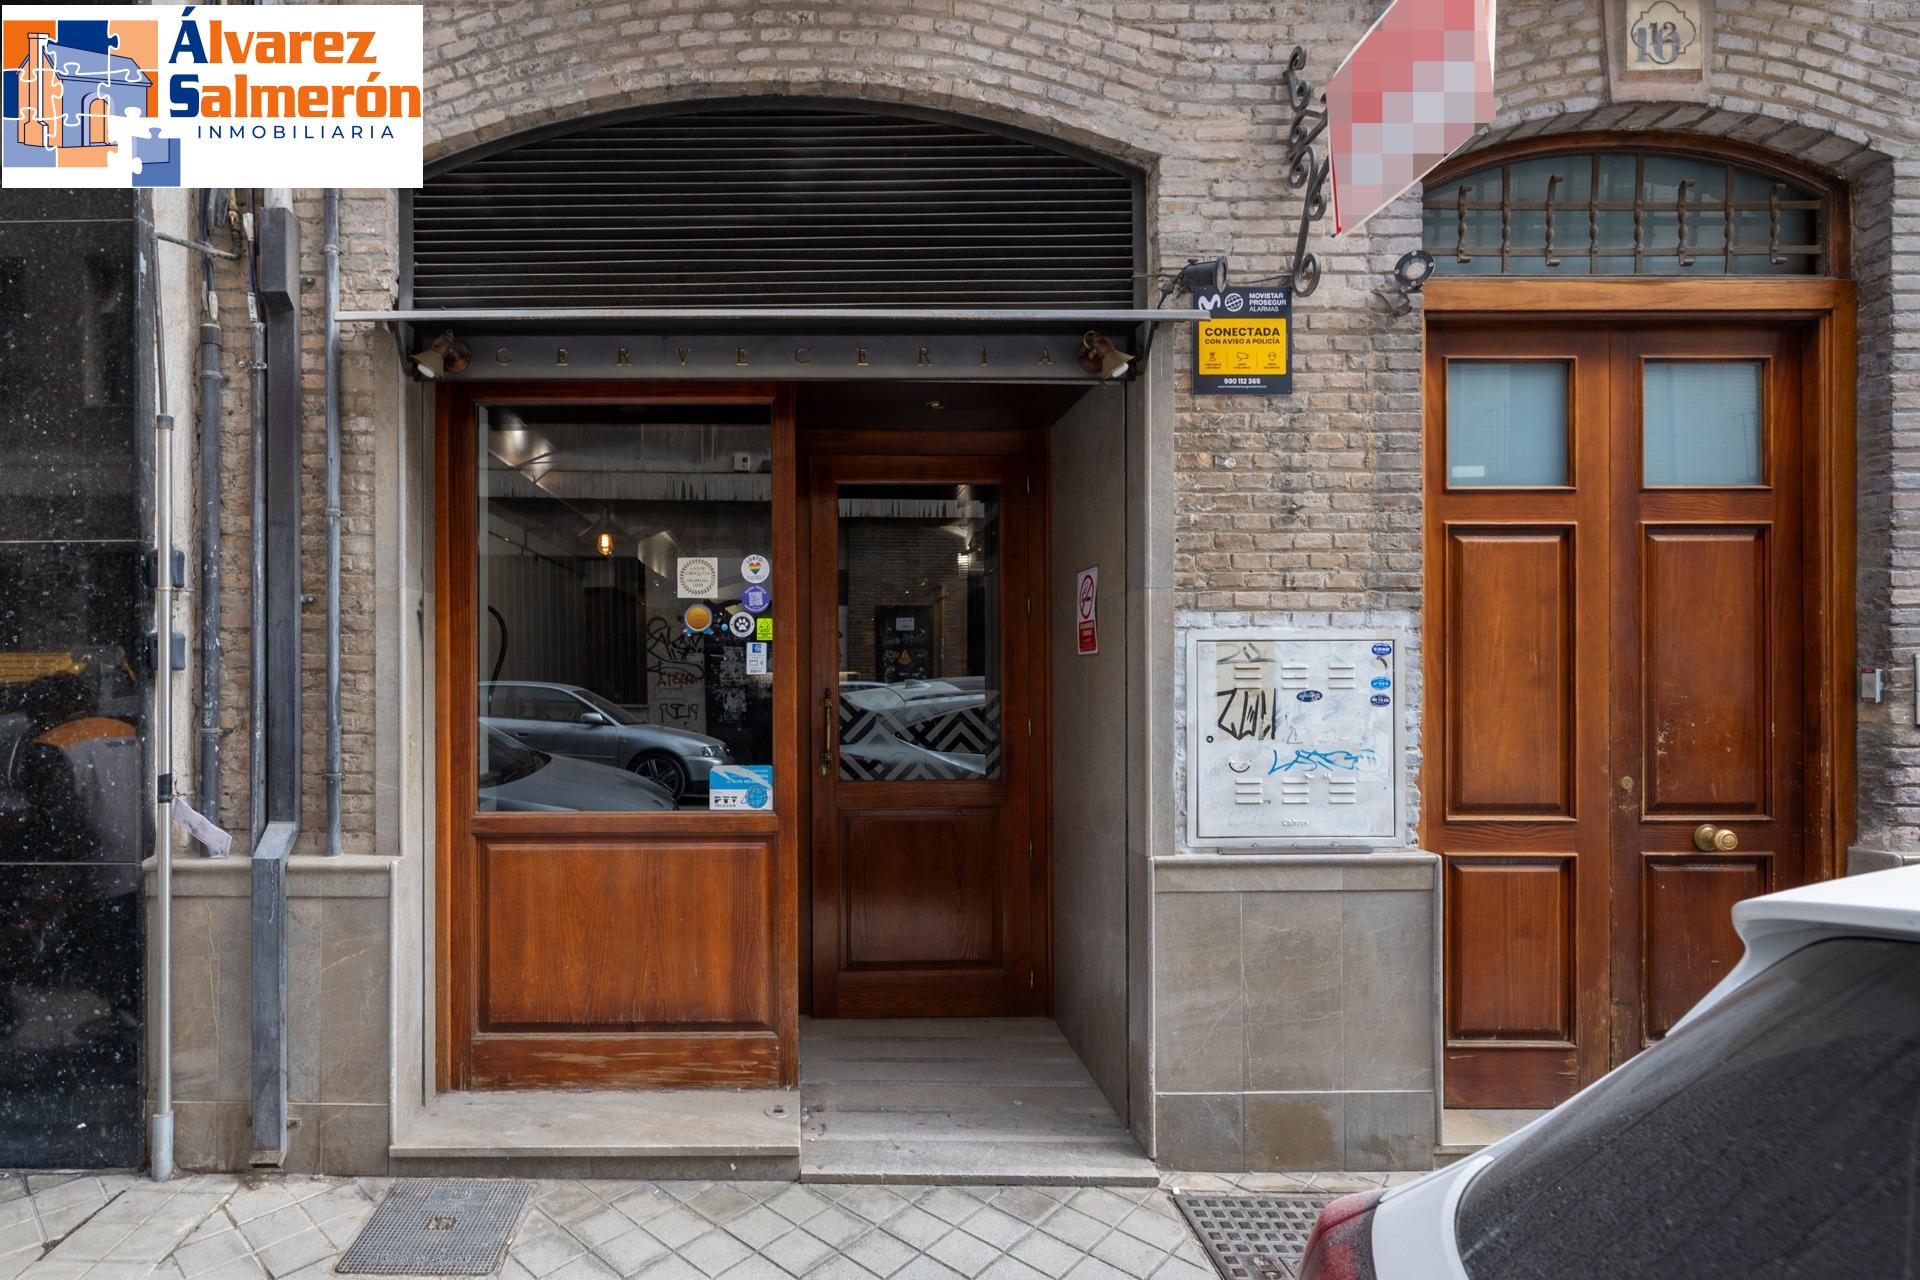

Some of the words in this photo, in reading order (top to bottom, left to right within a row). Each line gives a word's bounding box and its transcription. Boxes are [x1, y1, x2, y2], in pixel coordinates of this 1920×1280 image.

[1204, 327, 1281, 337] CONECTADA
[1252, 337, 1281, 345] POLICÍA
[495, 347, 1053, 367] CERVECERIA
[1223, 377, 1237, 385] 900
[1238, 377, 1247, 385] 112
[1247, 377, 1261, 385] 365
